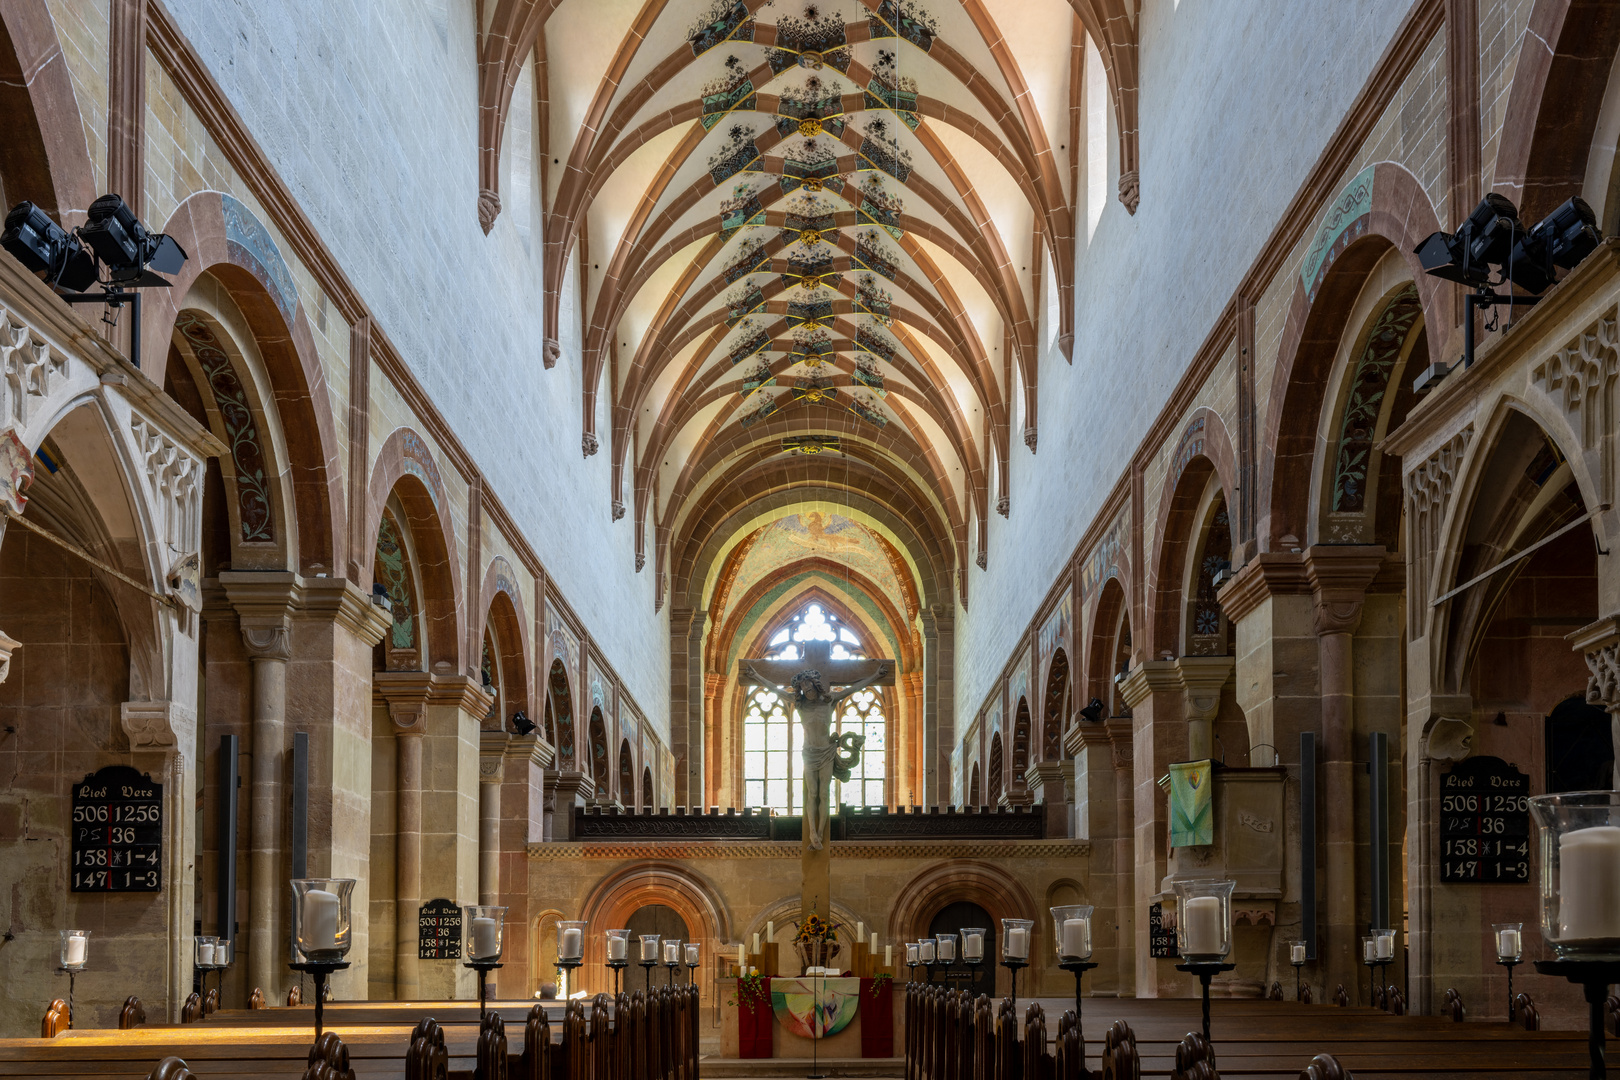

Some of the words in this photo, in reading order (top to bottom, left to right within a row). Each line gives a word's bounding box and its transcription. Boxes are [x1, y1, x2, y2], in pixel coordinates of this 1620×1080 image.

[1446, 775, 1474, 787] Lied
[1490, 776, 1521, 788] Vers
[79, 785, 107, 799] Lied
[121, 785, 153, 797] Vers
[1443, 795, 1478, 812] 506
[1484, 795, 1529, 812] 1256
[73, 805, 109, 822] 506
[114, 805, 160, 822] 1256
[1482, 817, 1505, 834] 36
[111, 827, 136, 844] 36
[1446, 838, 1478, 856] 158
[1496, 840, 1528, 857] 1-4
[74, 849, 107, 866] 158
[125, 849, 159, 866] 1-4
[1445, 861, 1478, 878] 147
[1495, 861, 1528, 878] 1-3
[74, 871, 108, 888] 147
[125, 871, 158, 888] 1-3
[420, 918, 436, 926] 506
[439, 918, 461, 926] 1256
[1151, 916, 1162, 924] 50
[438, 928, 449, 936] 36
[421, 939, 436, 947] 158
[1152, 937, 1167, 945] 158
[421, 949, 436, 957] 147
